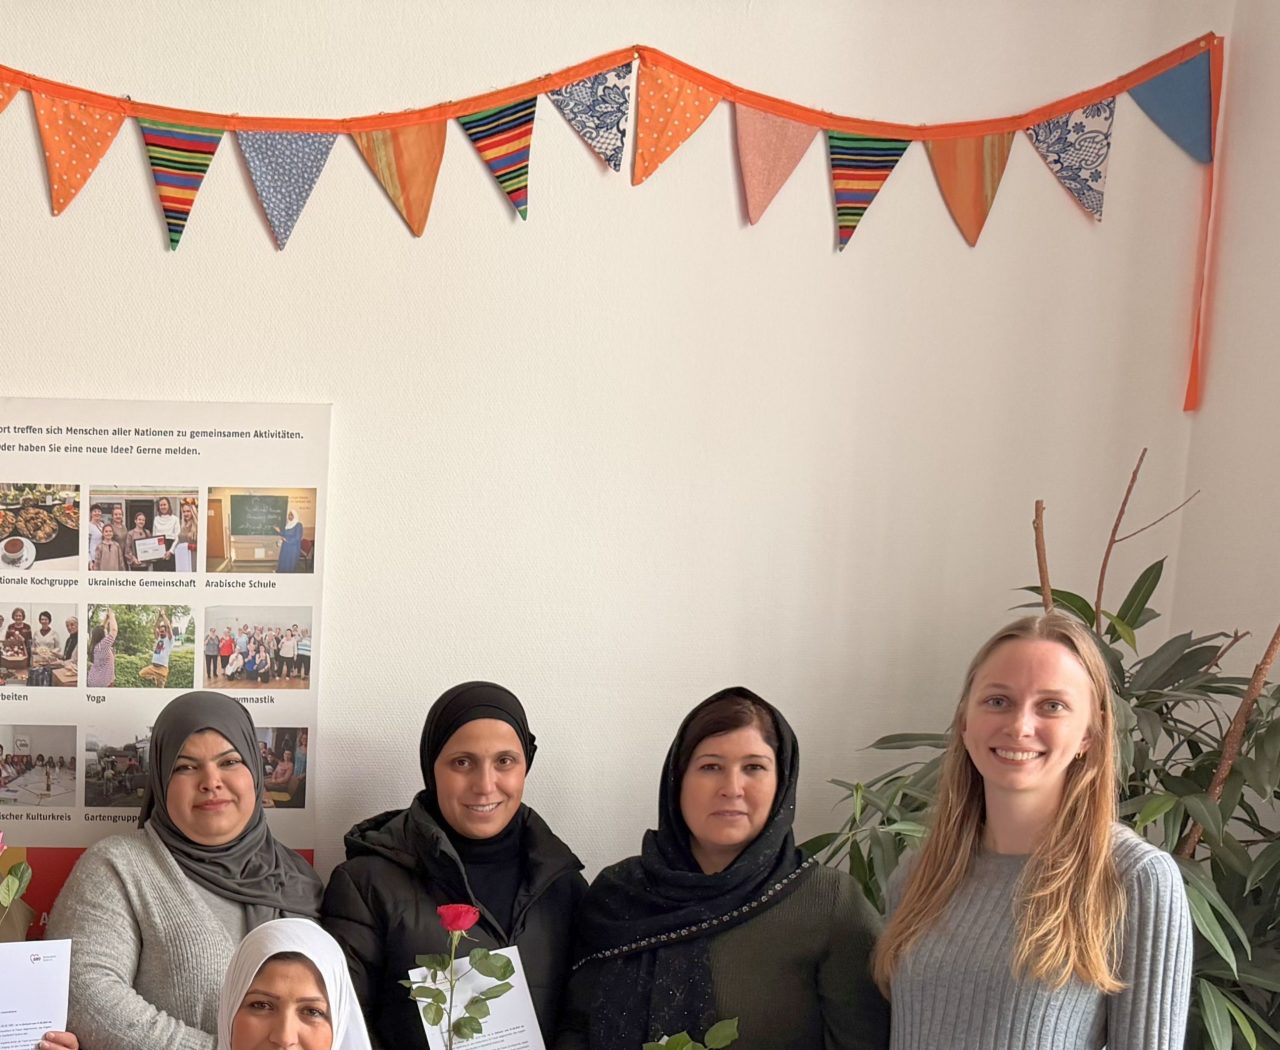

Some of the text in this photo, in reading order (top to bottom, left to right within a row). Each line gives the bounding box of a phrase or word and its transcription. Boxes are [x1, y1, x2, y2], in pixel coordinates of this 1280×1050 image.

[13, 424, 43, 435] treffen
[45, 425, 63, 435] sich
[66, 426, 109, 436] Menschen
[112, 426, 132, 437] aller
[134, 427, 174, 438] Nationen
[176, 429, 187, 438] zu
[190, 428, 251, 440] gemeinsamen
[253, 429, 304, 440] Aktivitäten.
[18, 442, 46, 453] haben
[48, 442, 61, 453] Sie
[64, 443, 83, 454] eine
[85, 446, 108, 454] neue
[110, 444, 133, 455] Idee?
[136, 445, 162, 455] Gerne
[164, 445, 201, 456] melden.
[30, 576, 79, 588] Kochgruppe
[88, 577, 196, 588] Ukrainische Gemeinschaft
[205, 579, 277, 589] Arabische Schule
[86, 693, 106, 705] Yoga
[26, 812, 72, 822] Kulturkreis
